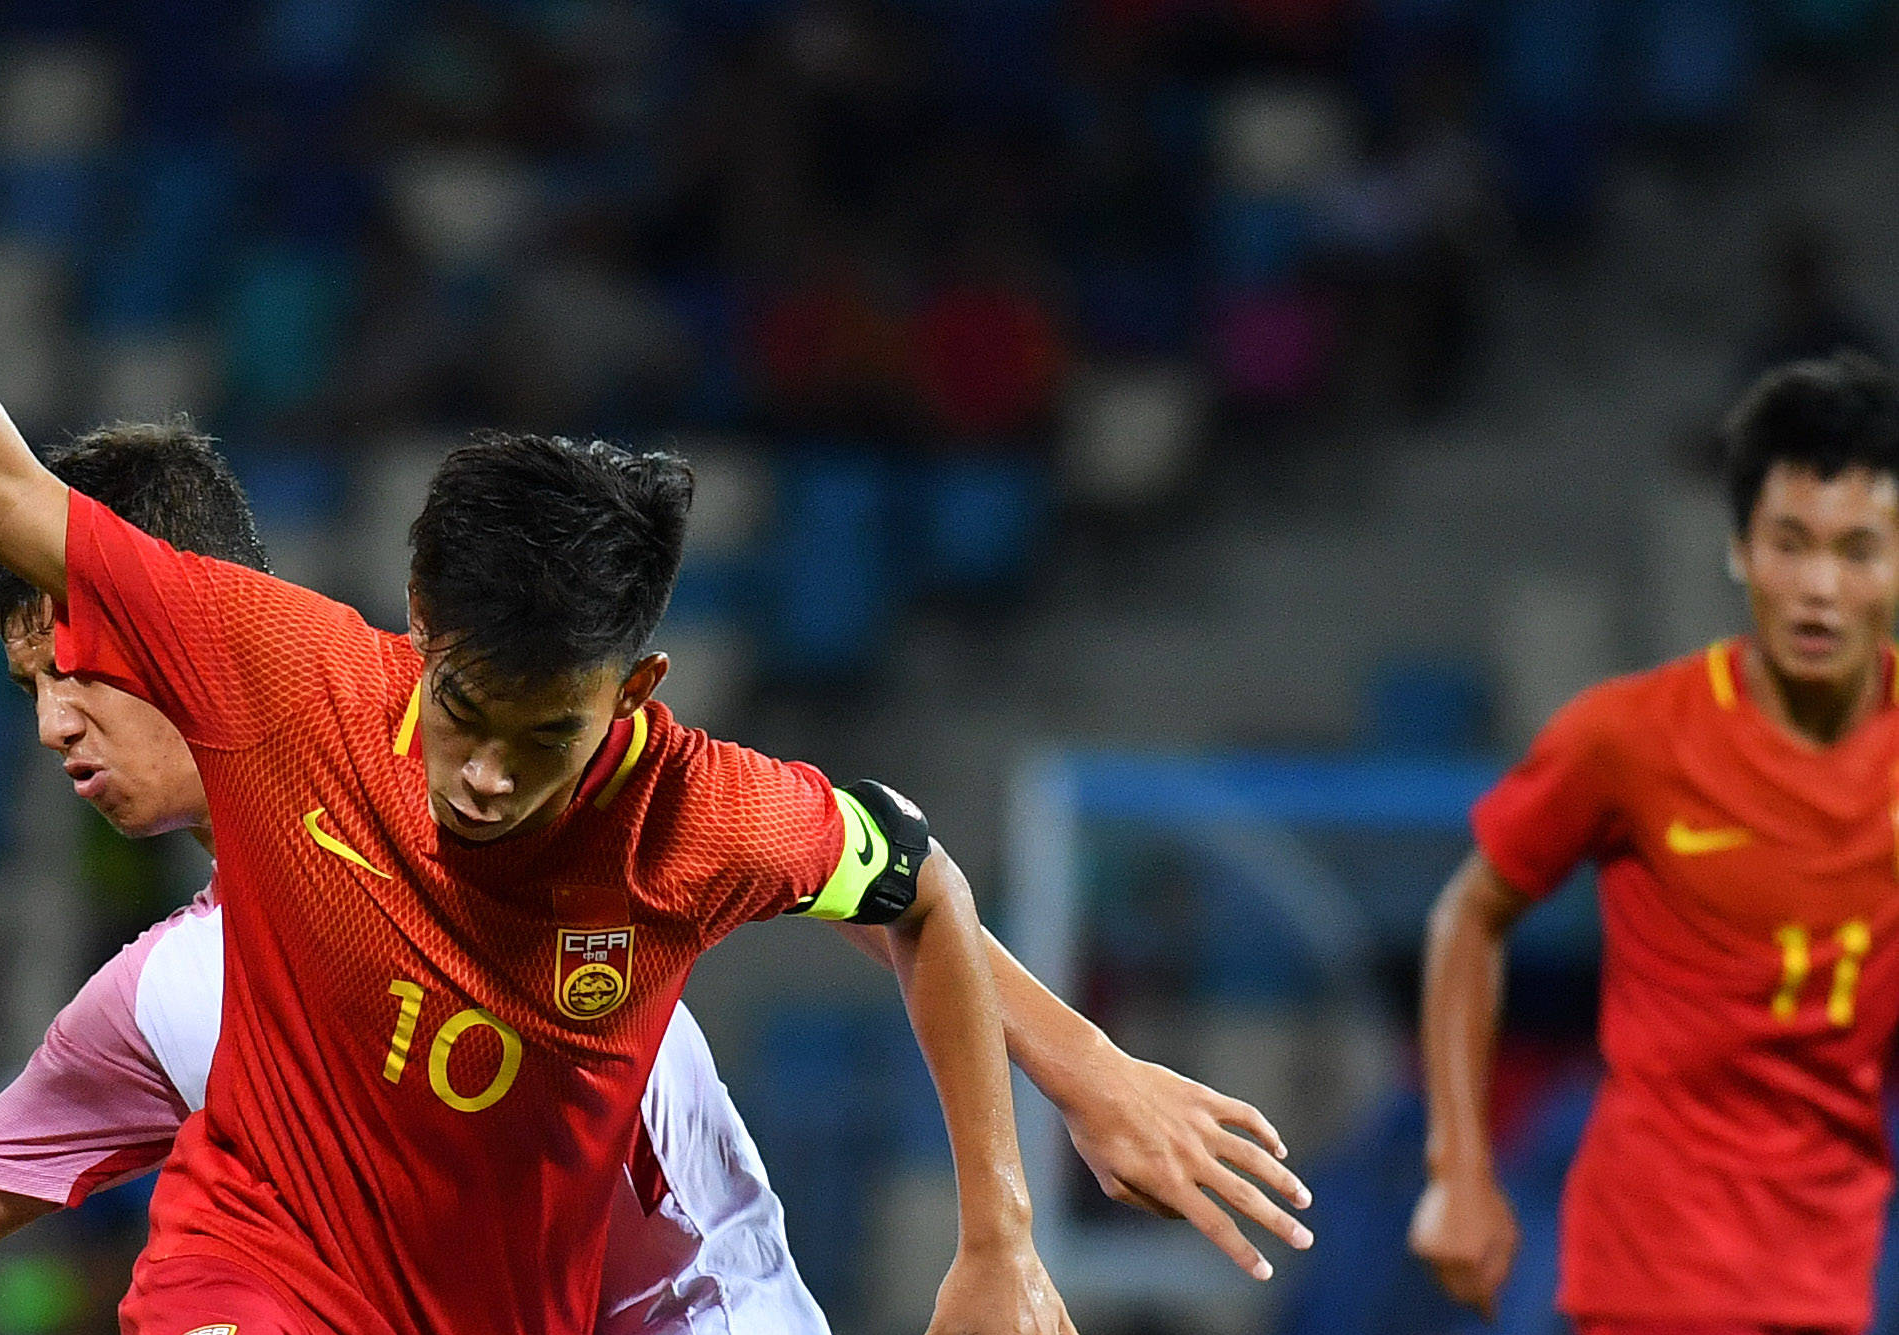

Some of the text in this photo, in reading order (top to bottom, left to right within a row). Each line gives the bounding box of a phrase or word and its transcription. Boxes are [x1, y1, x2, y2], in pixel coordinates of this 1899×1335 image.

[565, 933, 628, 951] CFA
[1771, 922, 1871, 1027] 11
[382, 979, 522, 1112] 10
